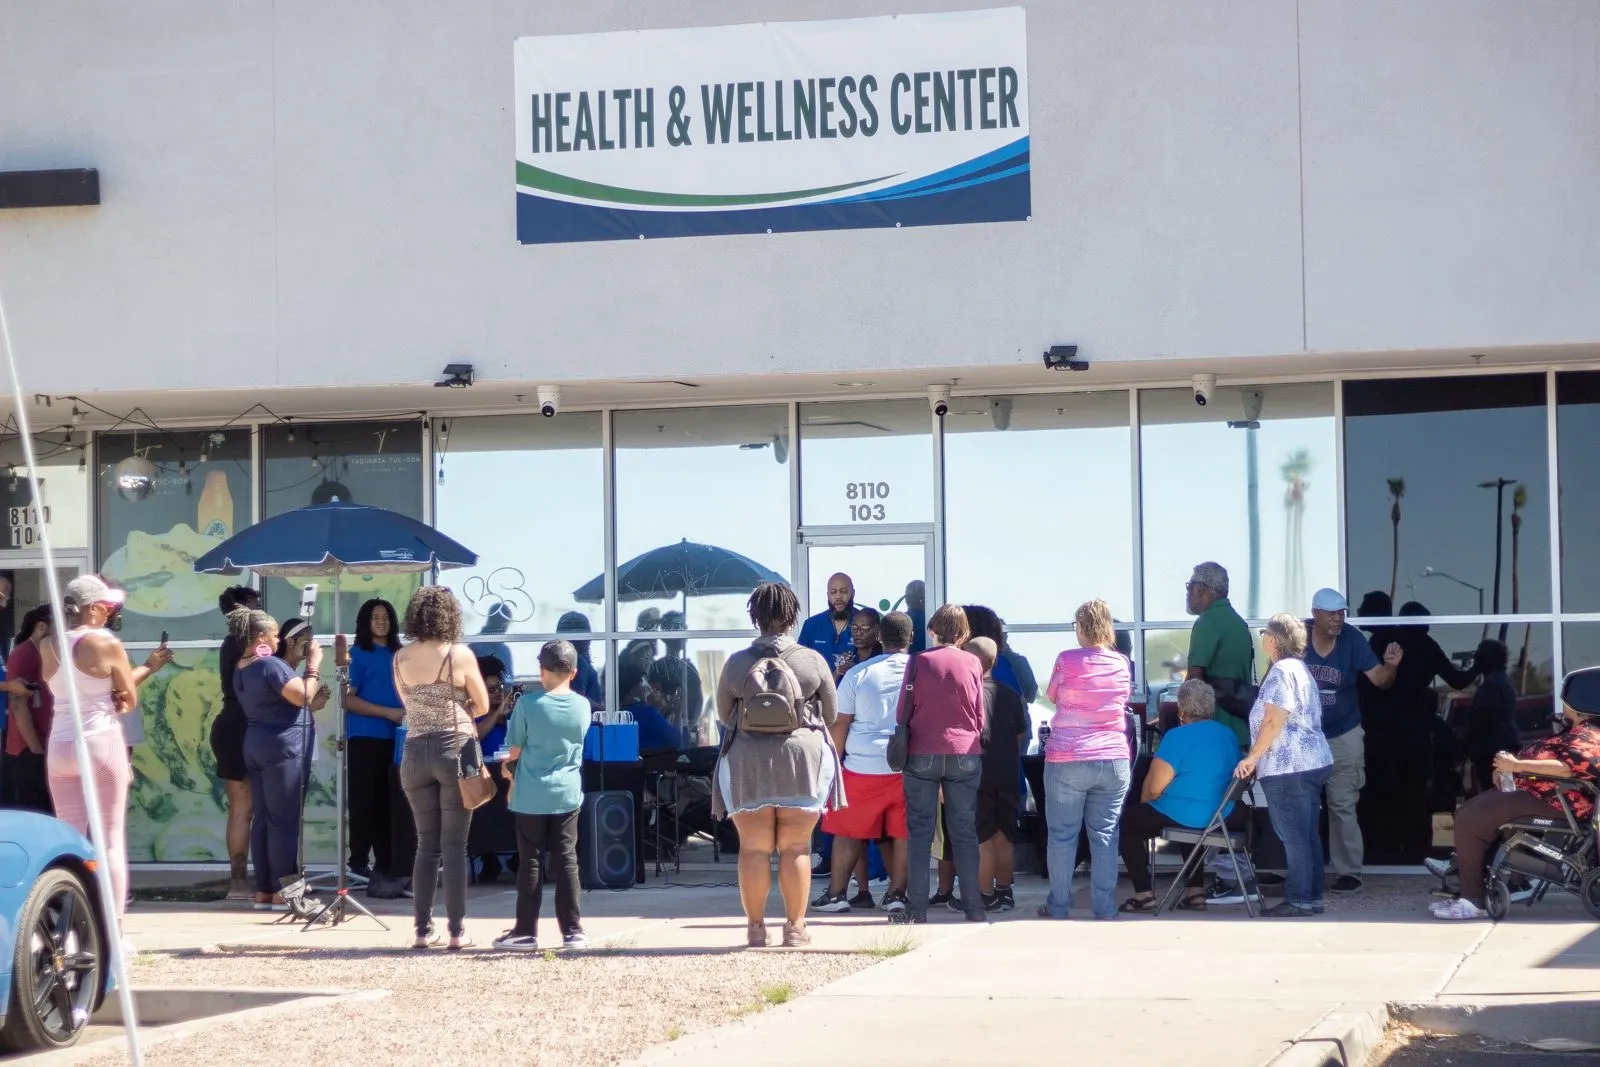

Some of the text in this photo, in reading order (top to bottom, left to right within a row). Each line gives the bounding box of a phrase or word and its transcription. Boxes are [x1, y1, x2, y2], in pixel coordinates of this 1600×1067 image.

[531, 66, 1020, 153] HEALTH & WELLNESS CENTER
[846, 481, 890, 500] 8110
[849, 503, 886, 521] 103
